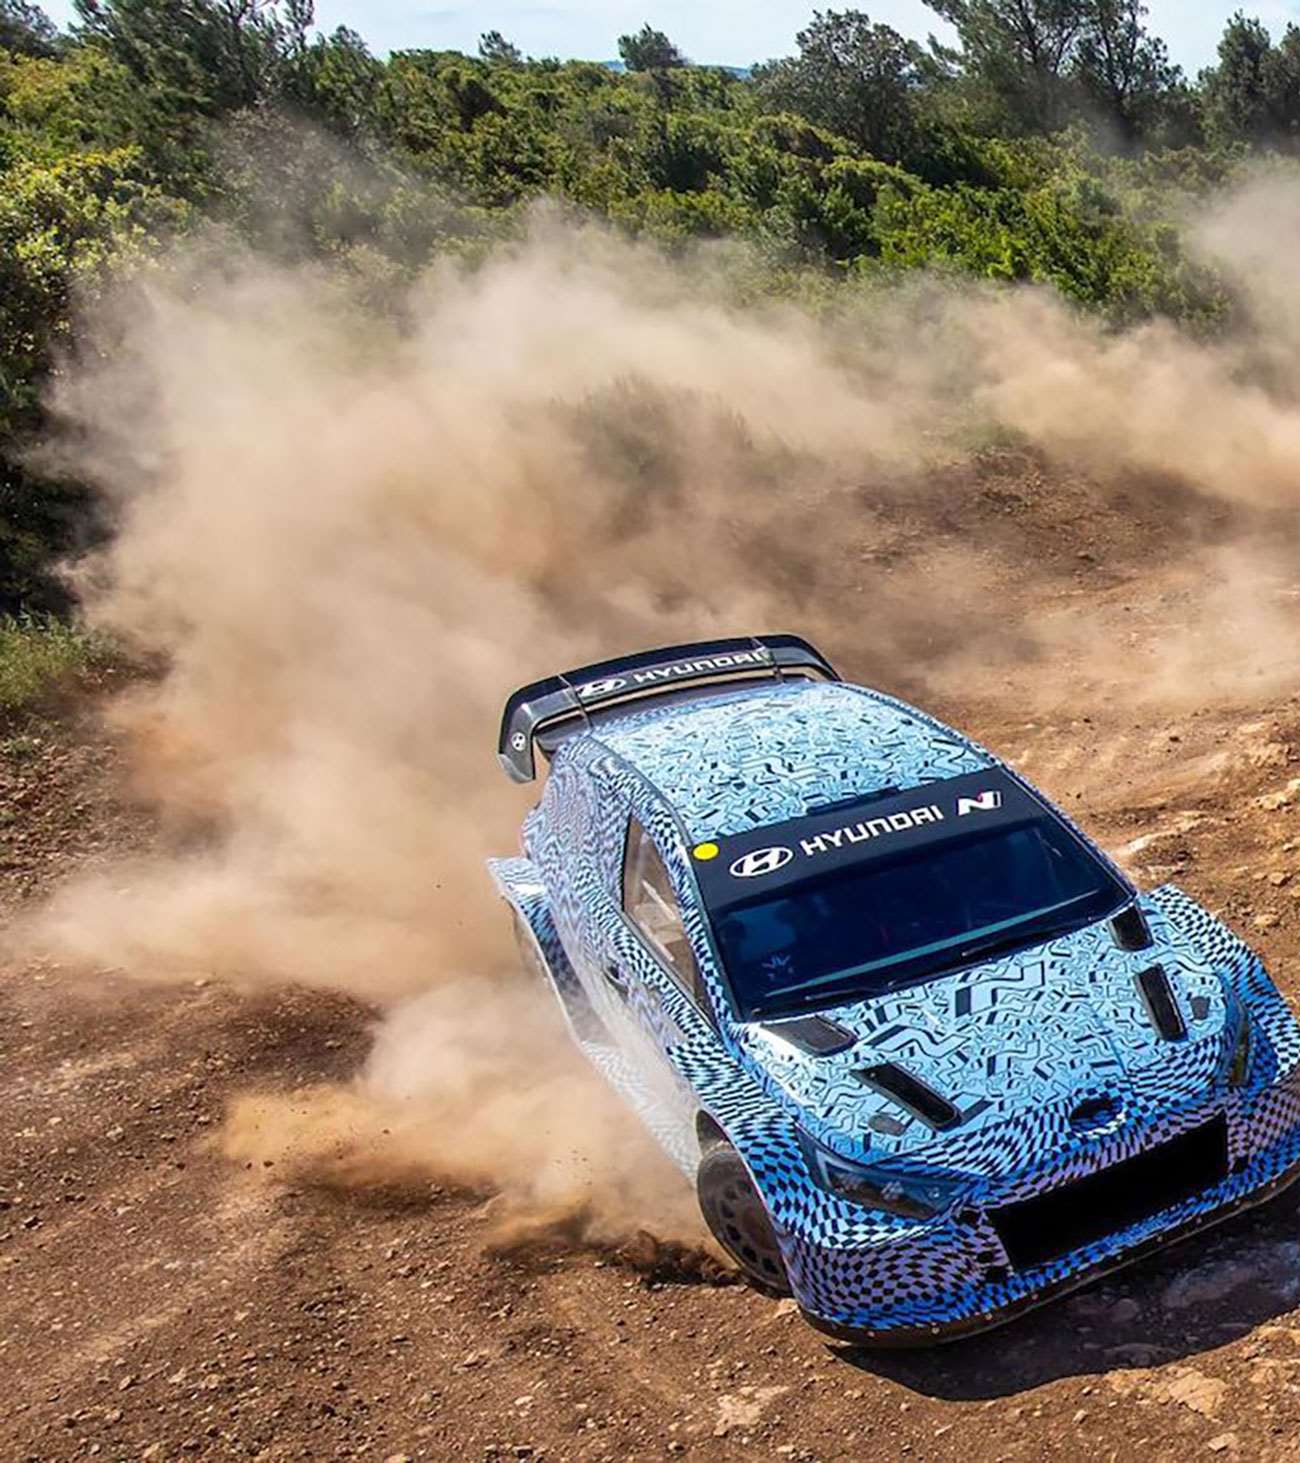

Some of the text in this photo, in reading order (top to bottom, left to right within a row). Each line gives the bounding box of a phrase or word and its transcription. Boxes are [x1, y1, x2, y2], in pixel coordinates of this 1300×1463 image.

[632, 649, 766, 683] HYUNDAI
[800, 791, 1001, 856] HYUNDAI N
